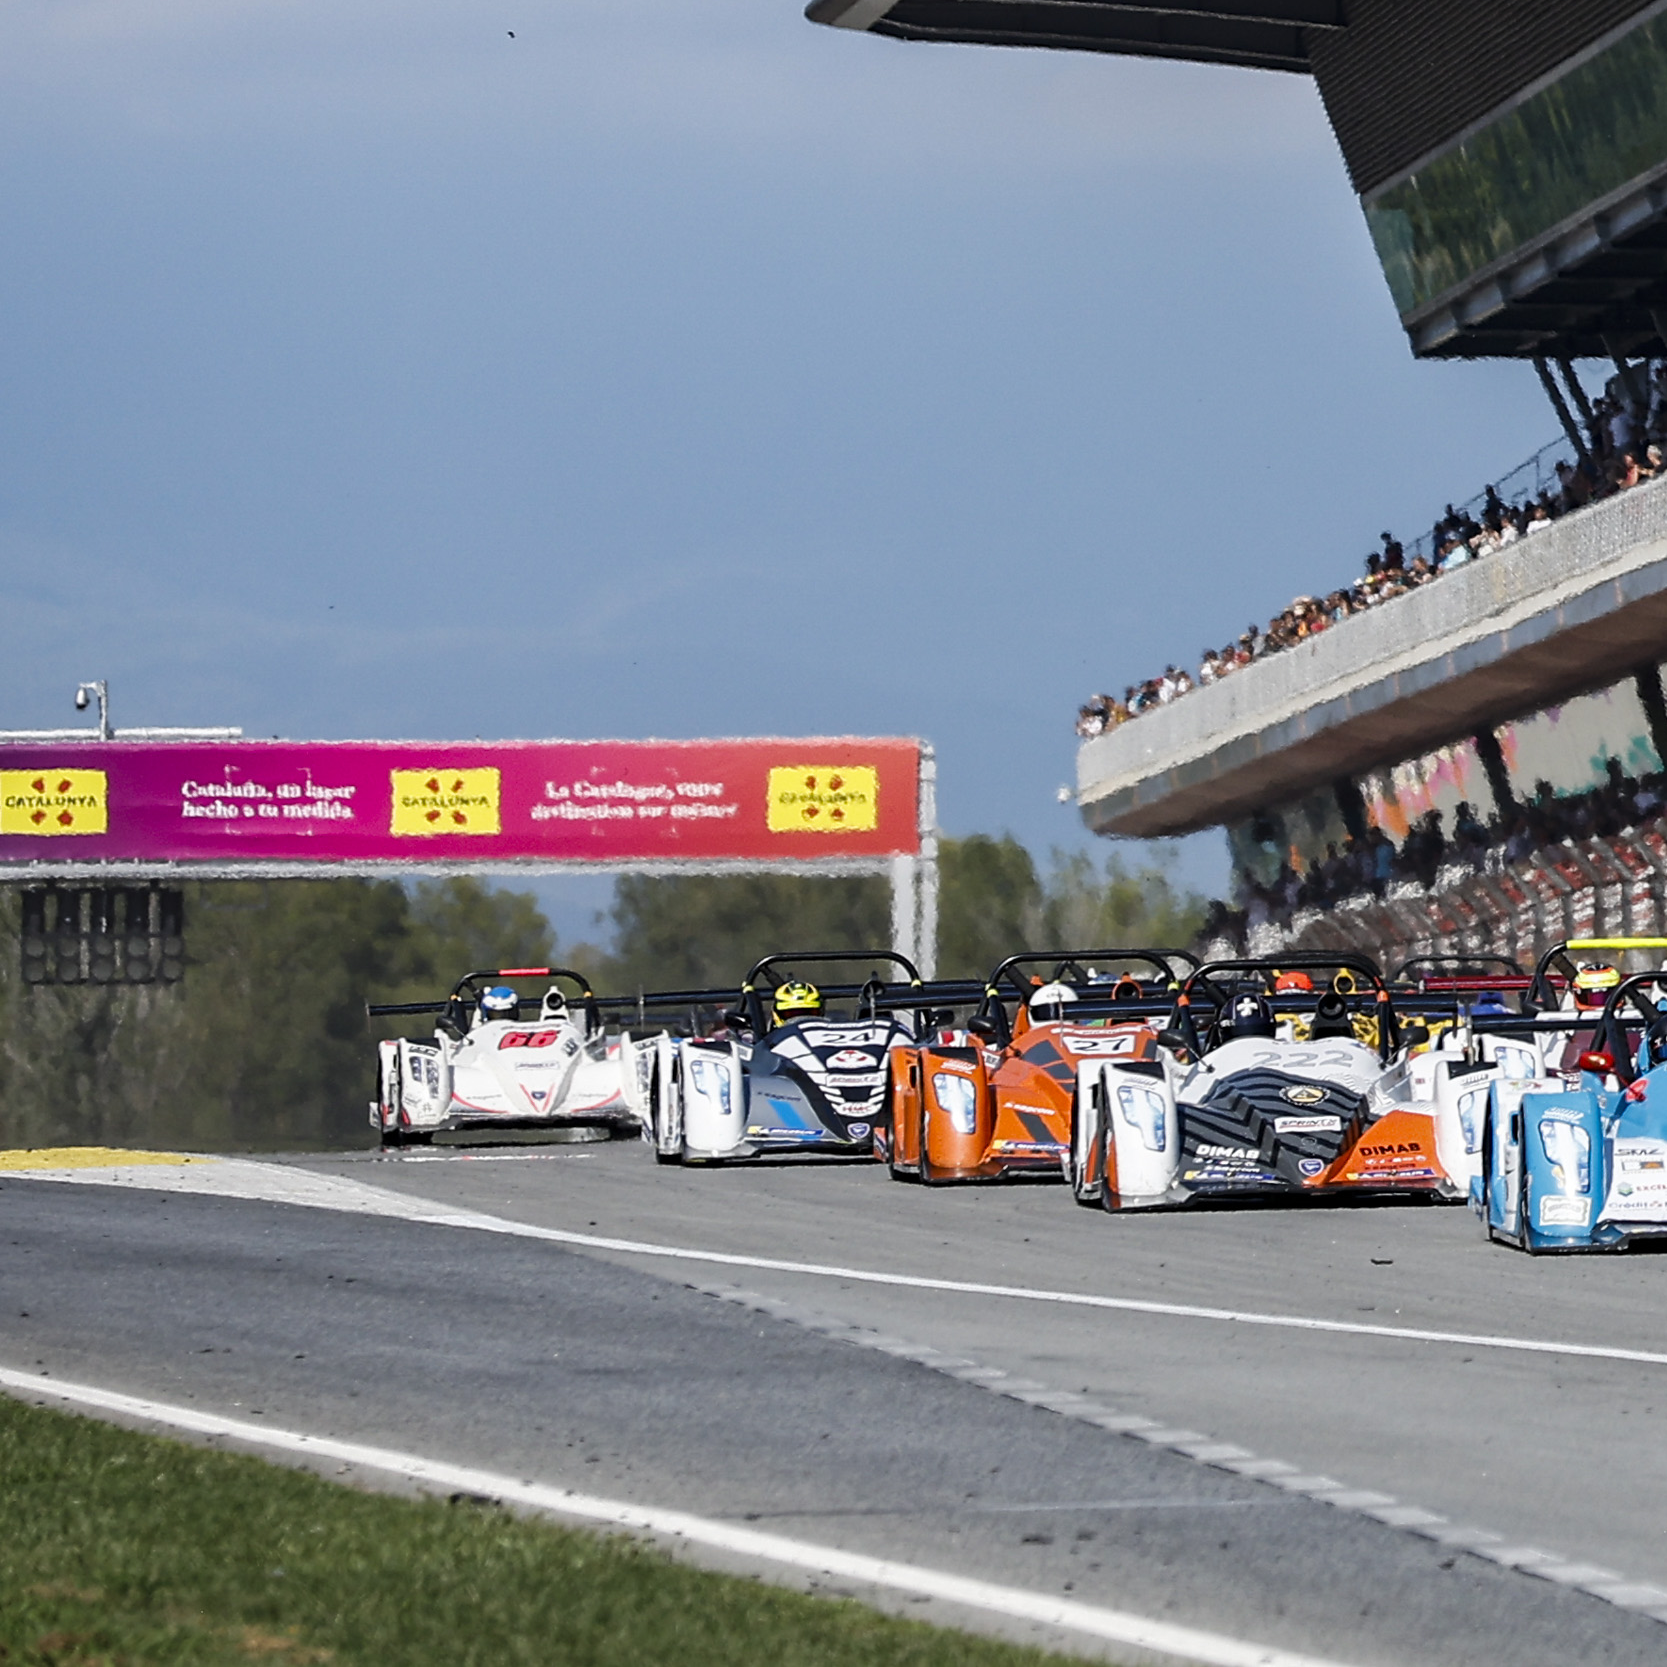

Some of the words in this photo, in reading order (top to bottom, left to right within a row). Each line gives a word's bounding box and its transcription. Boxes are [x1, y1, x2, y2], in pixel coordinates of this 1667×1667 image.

[5, 795, 97, 809] CATALUNYA
[402, 794, 490, 808] CATALUNYA
[181, 800, 238, 818] hecho
[257, 803, 278, 818] tu
[499, 1030, 563, 1050] 66
[820, 1032, 876, 1044] 24
[1071, 1038, 1129, 1051] 27
[1250, 1050, 1353, 1068] 222
[1196, 1144, 1260, 1159] DIMAB
[1360, 1142, 1421, 1157] DIMAB
